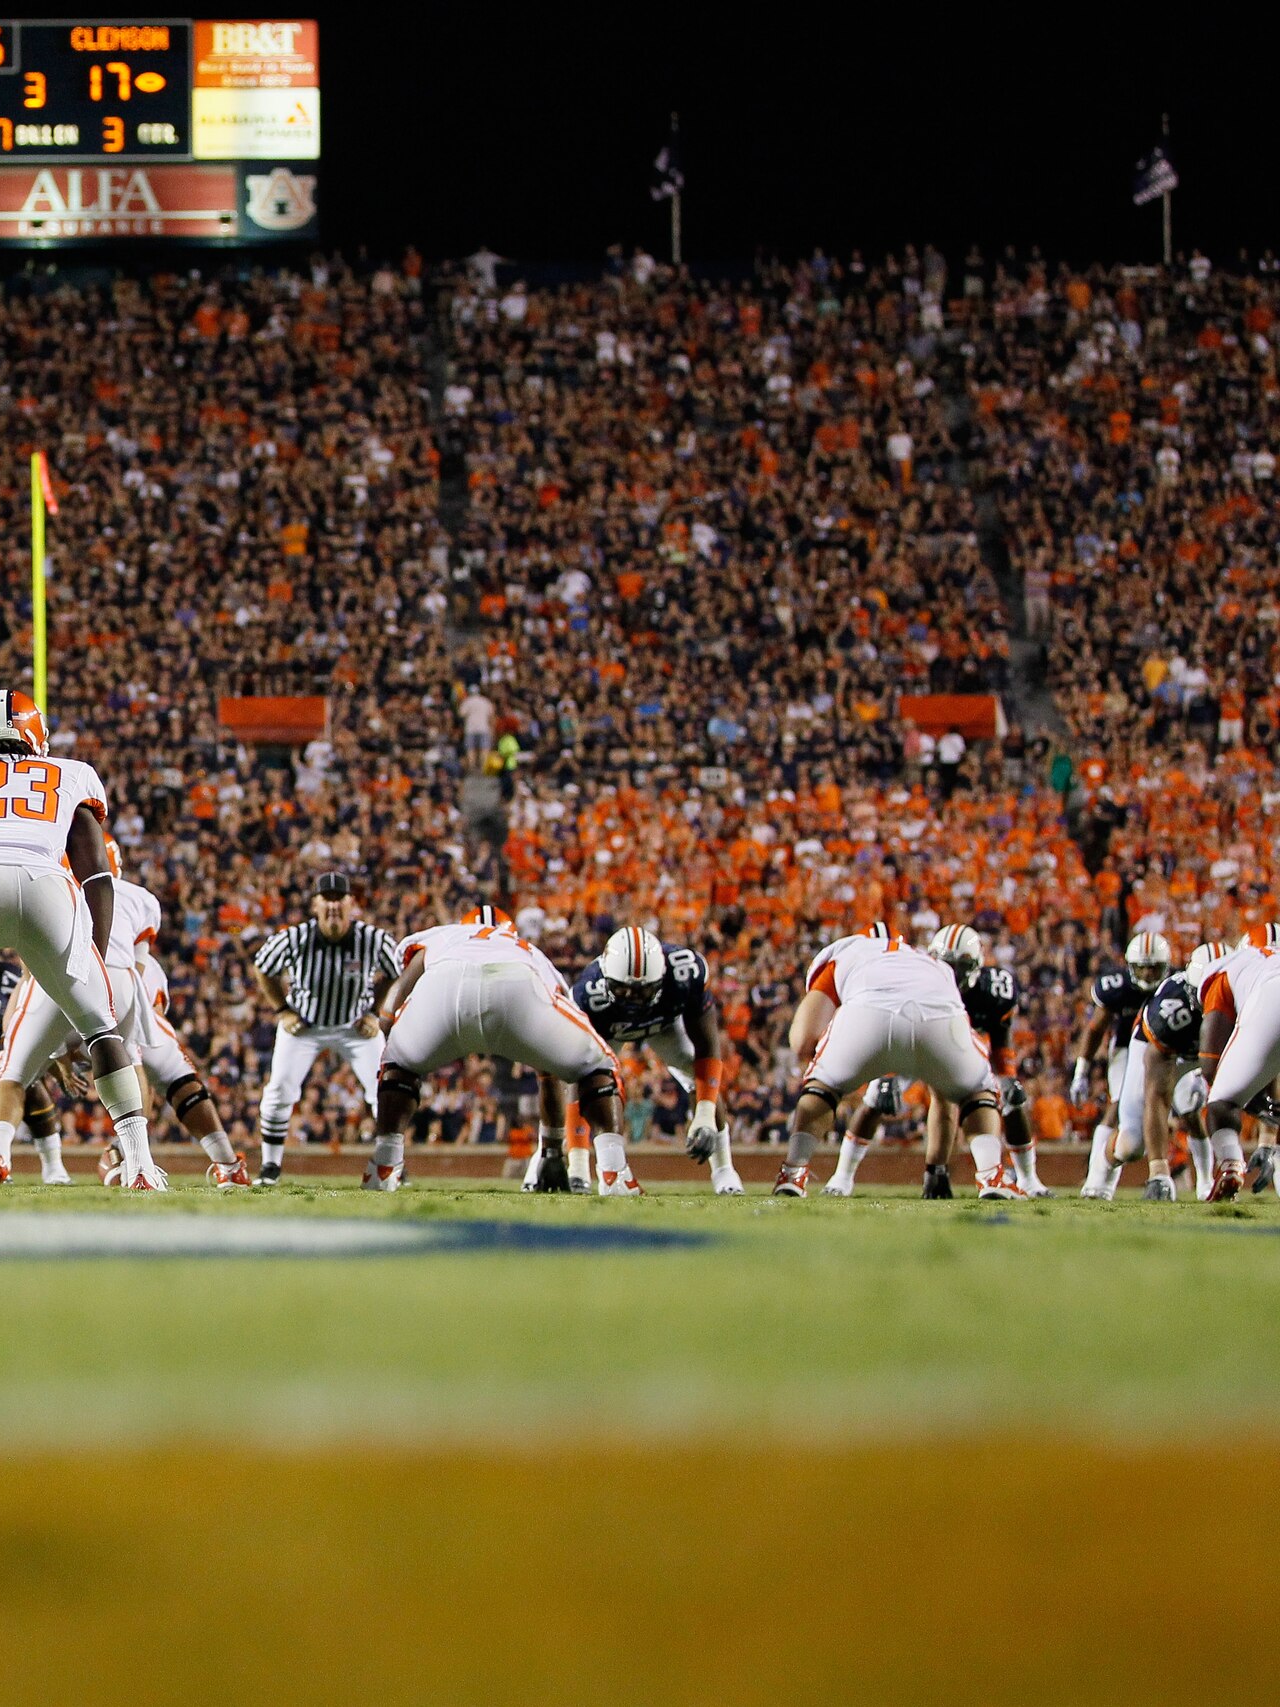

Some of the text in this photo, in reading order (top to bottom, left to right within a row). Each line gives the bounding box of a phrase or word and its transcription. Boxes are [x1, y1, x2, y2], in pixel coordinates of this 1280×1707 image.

[212, 22, 303, 55] BB&T
[23, 71, 47, 109] 3
[89, 62, 132, 102] 17
[101, 116, 126, 153] 3
[20, 168, 163, 216] ALFA
[17, 220, 164, 236] ISURANCE
[668, 948, 700, 982] 90
[989, 967, 1014, 1001] 25
[1100, 973, 1124, 992] 2
[1159, 998, 1193, 1031] 49
